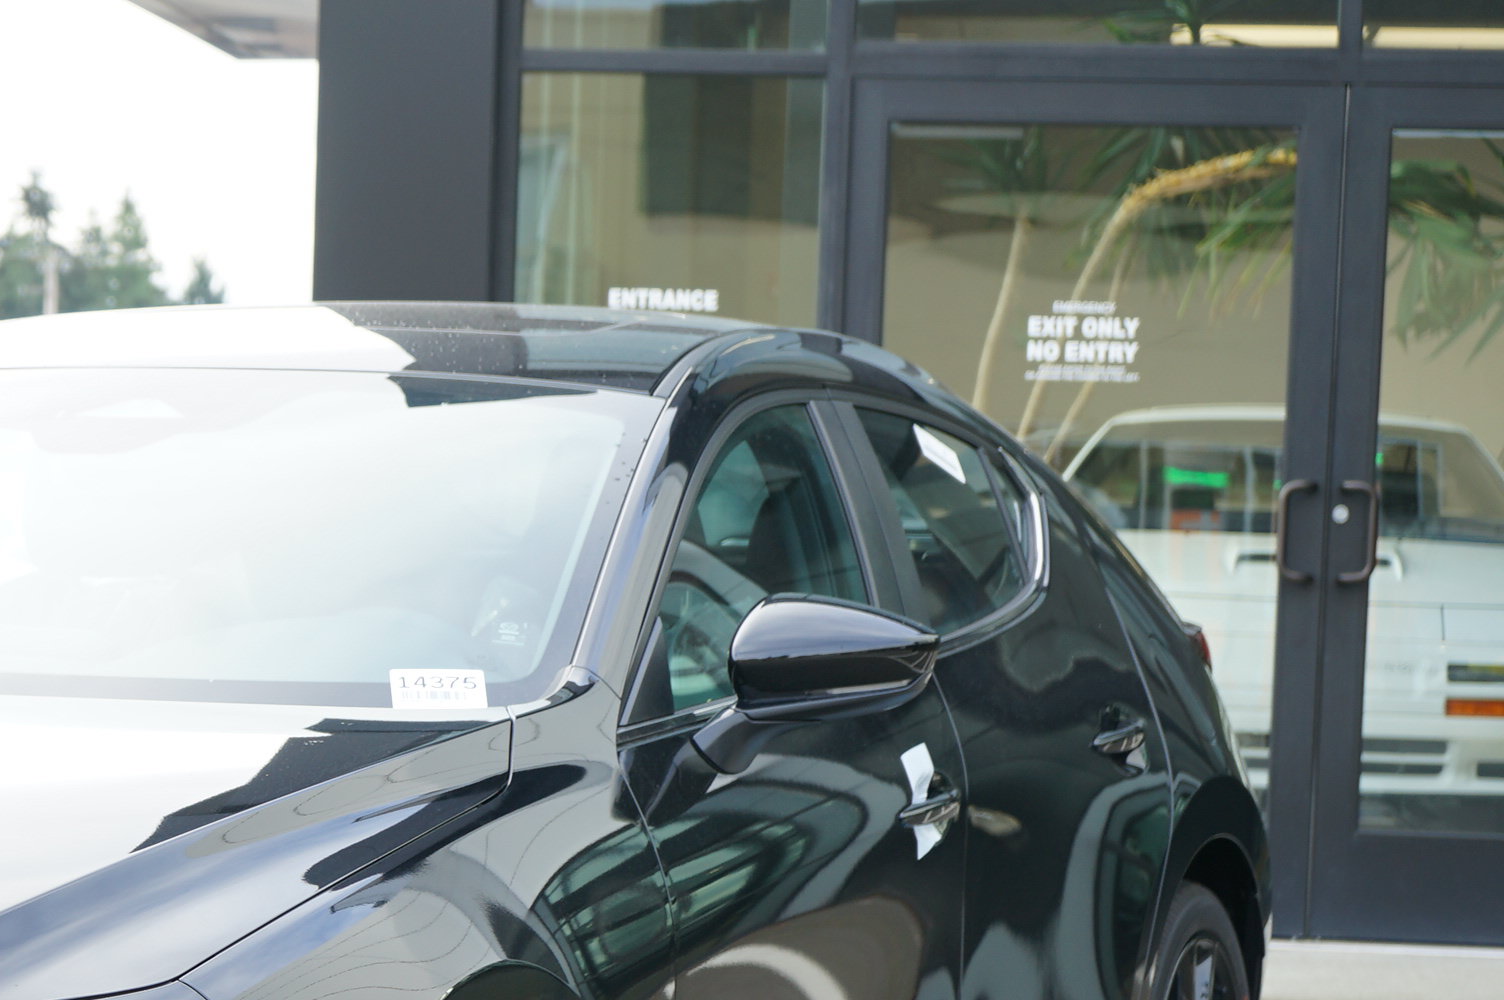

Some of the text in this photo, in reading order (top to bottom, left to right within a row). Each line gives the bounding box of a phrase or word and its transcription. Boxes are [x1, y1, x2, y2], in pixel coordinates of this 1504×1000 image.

[608, 287, 718, 312] ENTRANCE
[1027, 315, 1140, 339] EXIT ONLY
[1026, 339, 1139, 364] NO ENTRY
[398, 676, 478, 690] 14375
